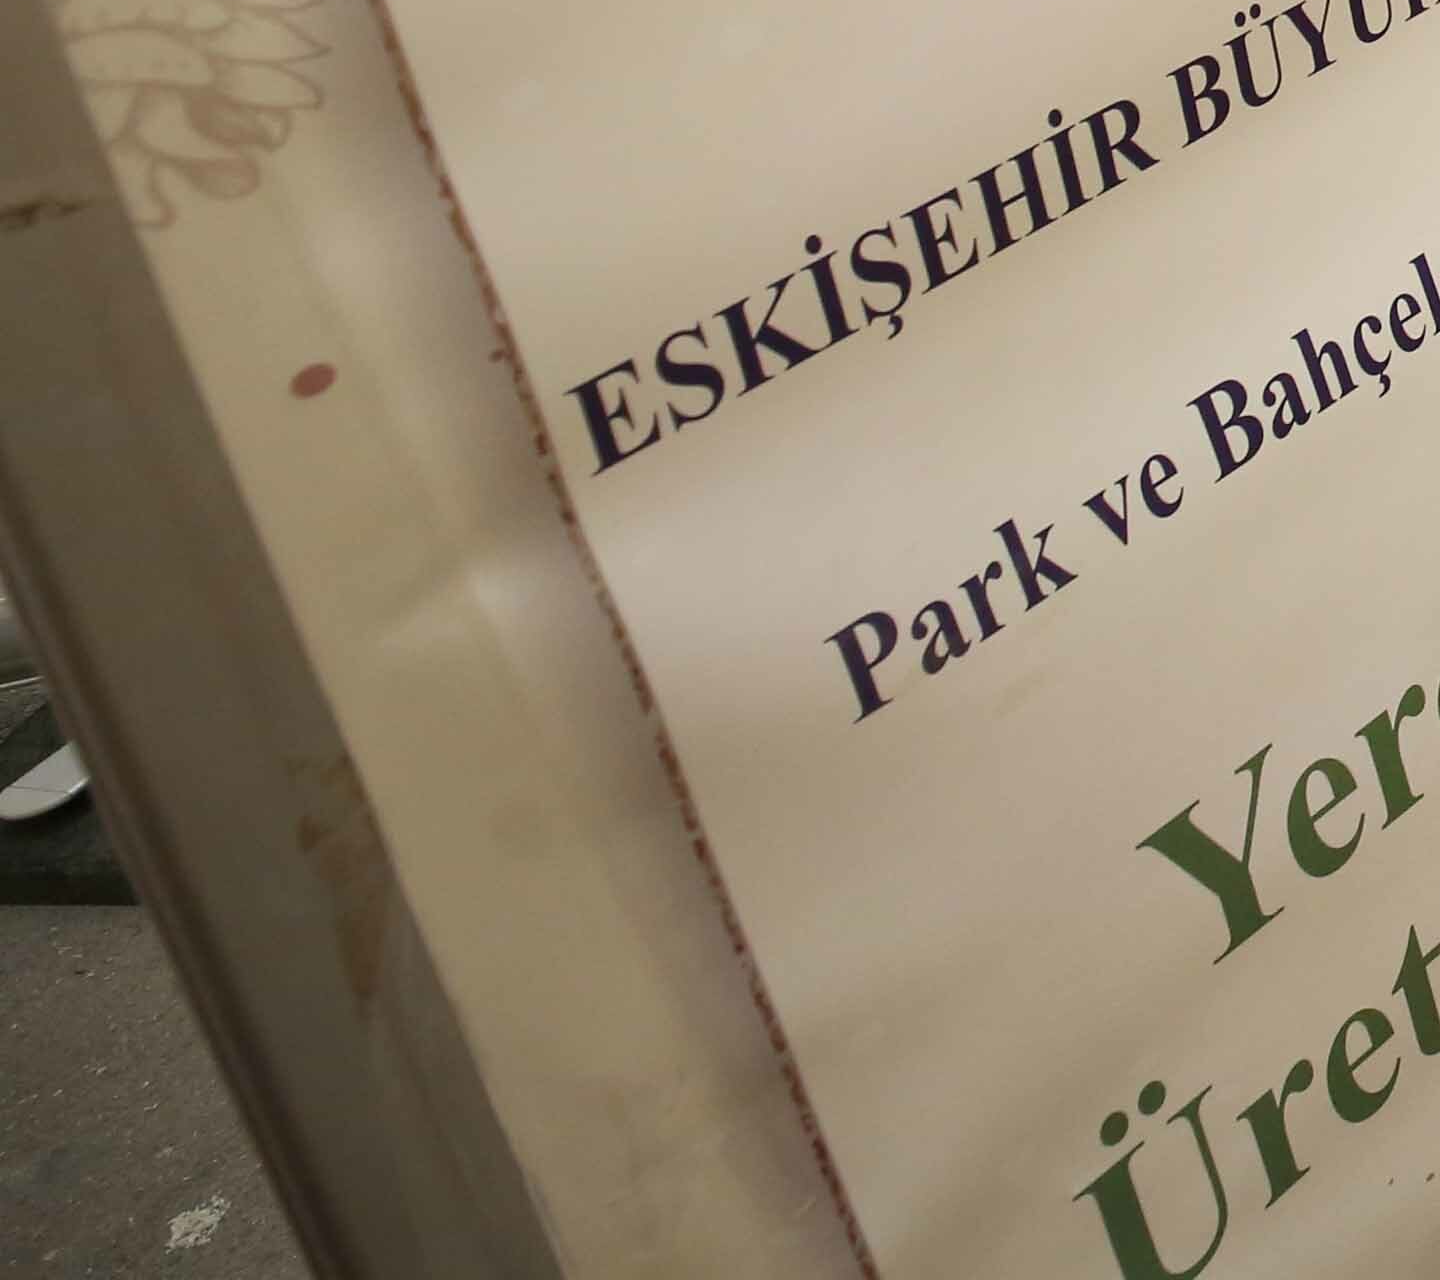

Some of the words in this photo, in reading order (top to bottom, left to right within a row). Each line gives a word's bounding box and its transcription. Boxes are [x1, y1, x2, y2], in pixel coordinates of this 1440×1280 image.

[564, 108, 1161, 478] ESKİŞEHİR
[823, 517, 1079, 724] Park
[1081, 451, 1185, 546] ve
